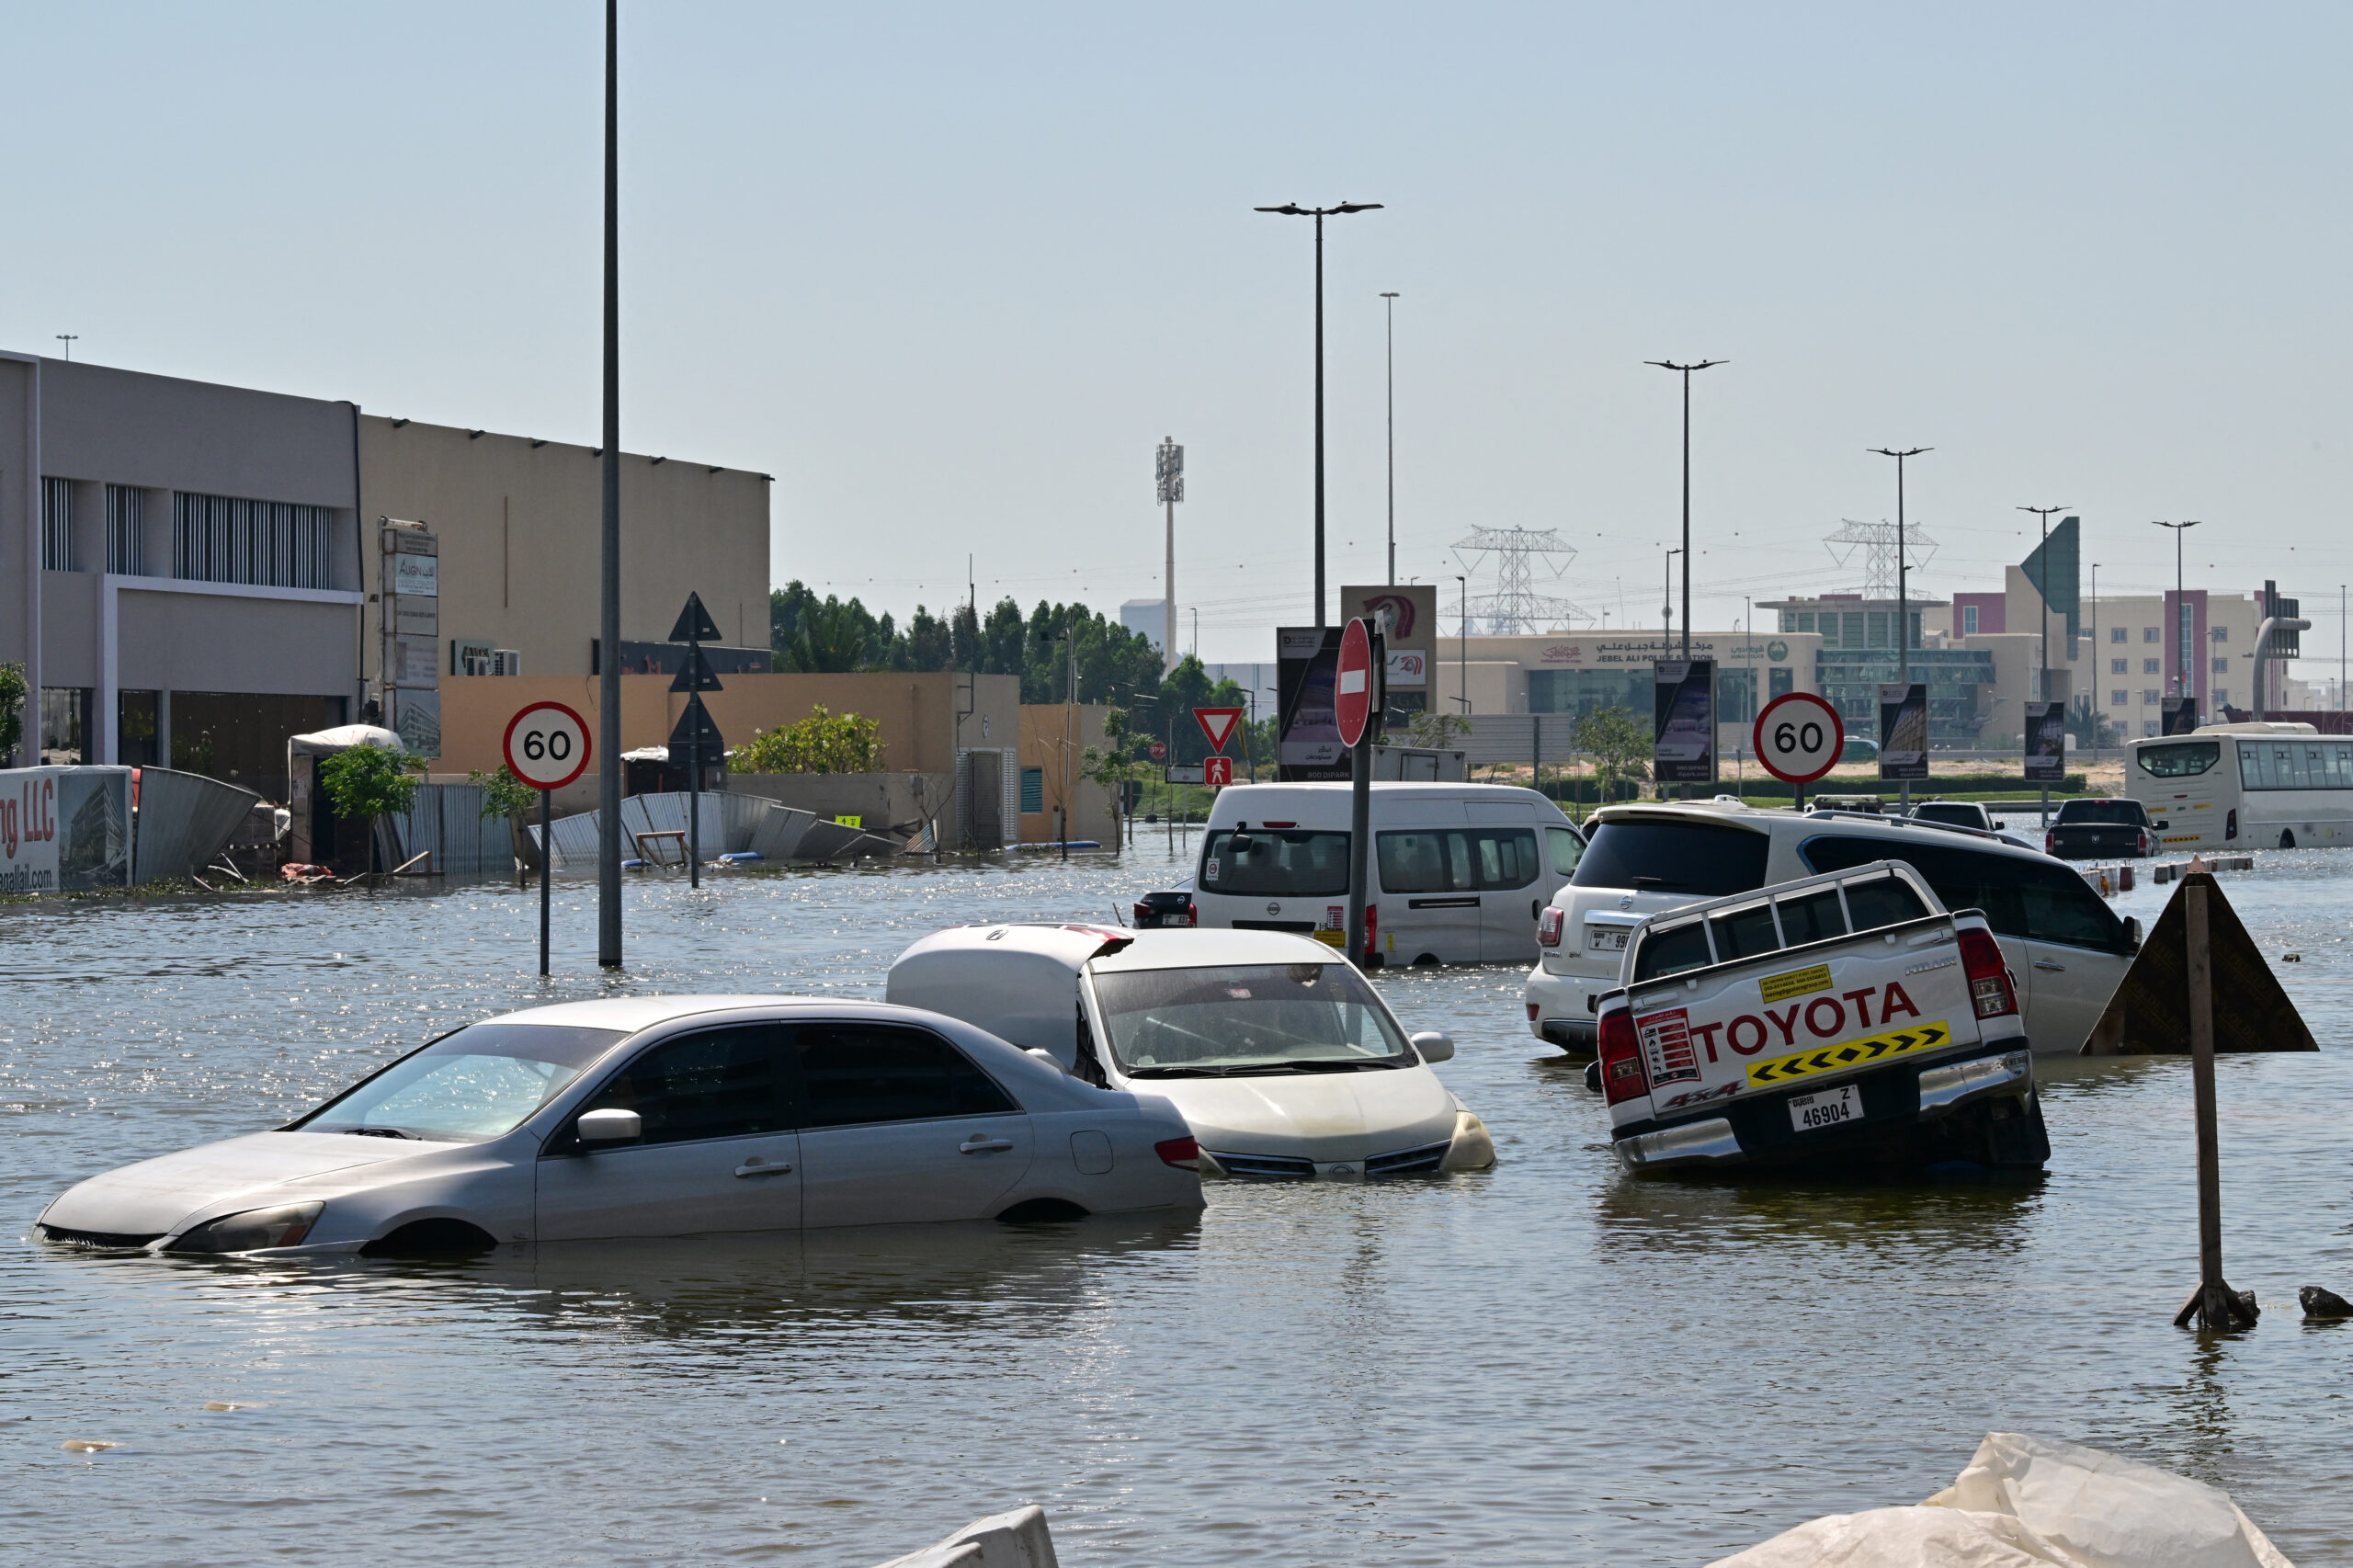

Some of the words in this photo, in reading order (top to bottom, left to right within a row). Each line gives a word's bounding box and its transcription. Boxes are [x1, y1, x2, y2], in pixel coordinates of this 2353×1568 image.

[524, 731, 571, 761] 60
[1775, 722, 1823, 754] 60
[23, 778, 54, 843] LLC
[1689, 982, 1921, 1063] TOYOTA
[1840, 1087, 1851, 1100] Z
[1802, 1101, 1850, 1128] 46904
